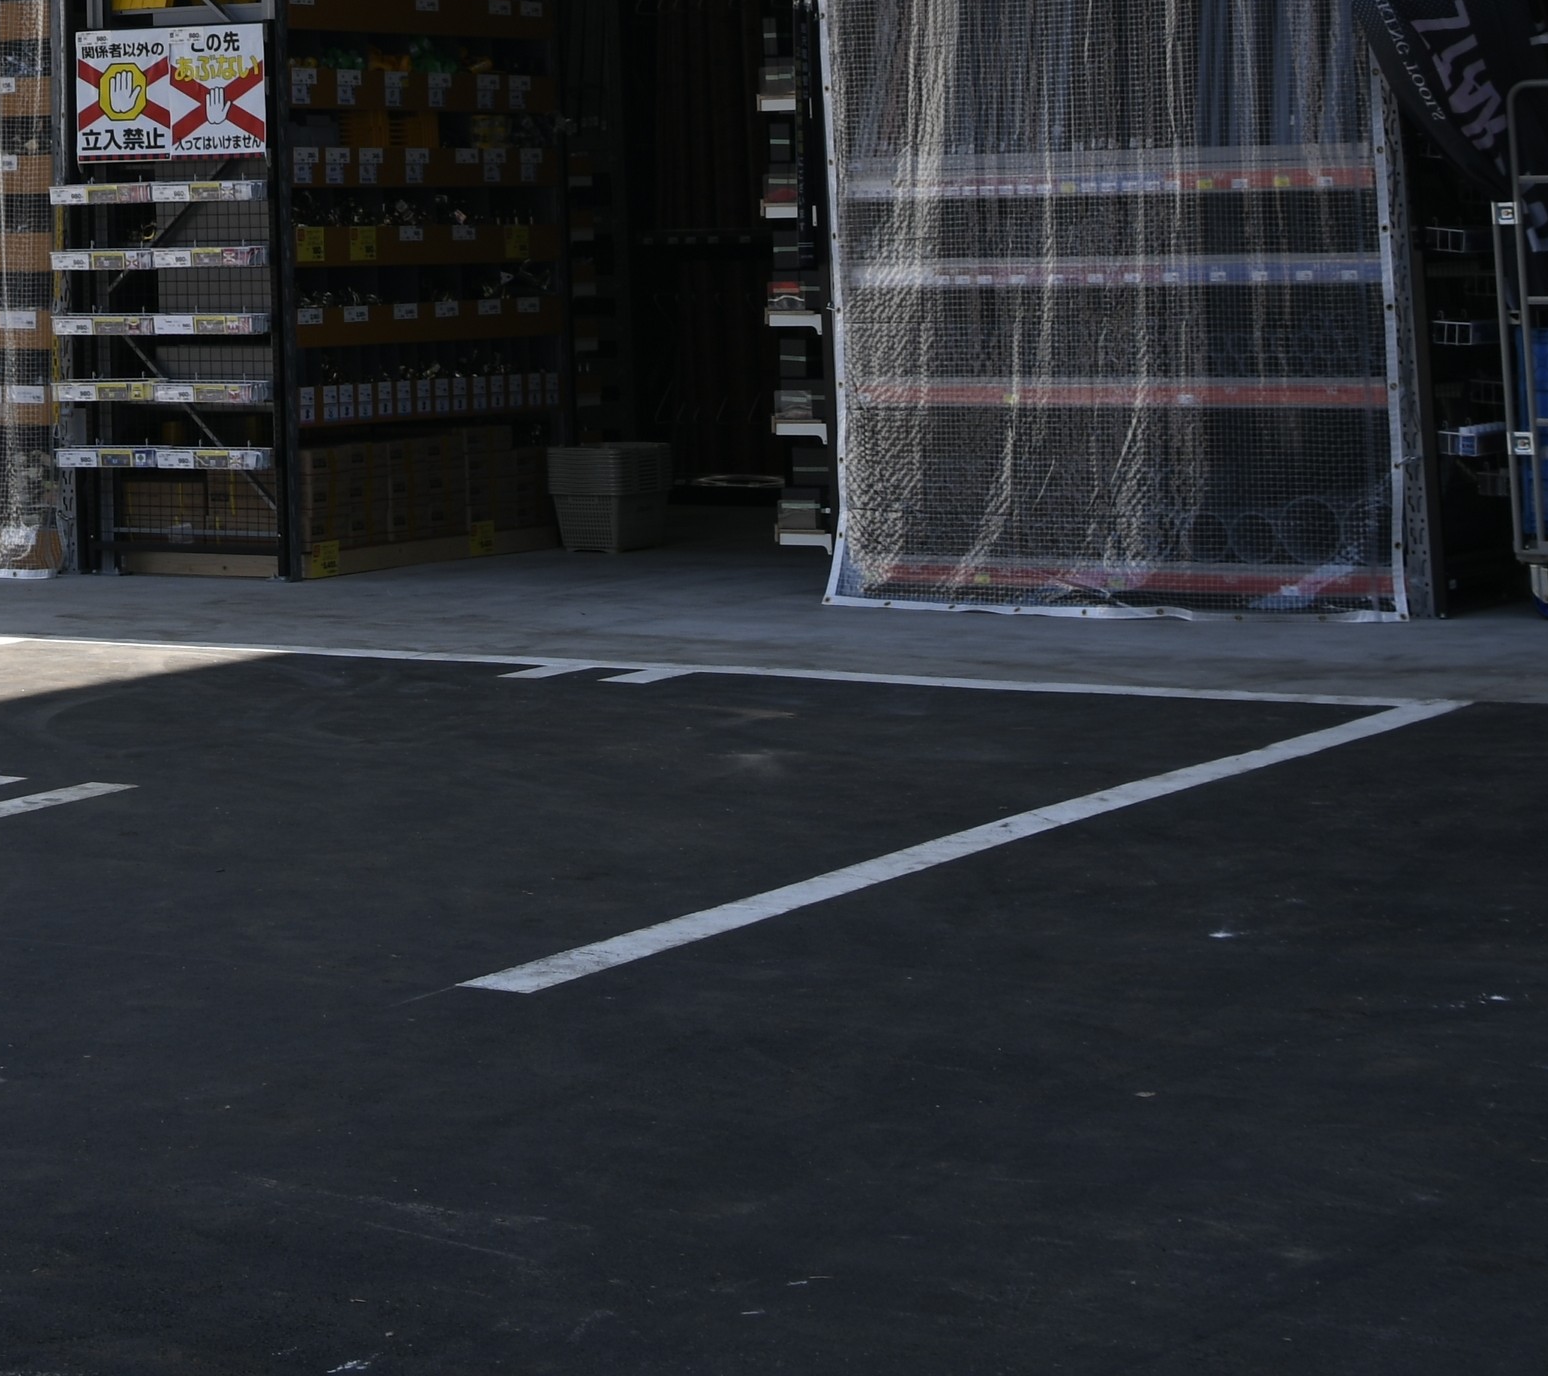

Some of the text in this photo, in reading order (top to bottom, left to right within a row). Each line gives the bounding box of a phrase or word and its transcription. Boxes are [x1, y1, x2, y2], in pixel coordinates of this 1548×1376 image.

[81, 42, 164, 59] 関係者以外の
[174, 54, 259, 82] あぶない
[82, 127, 165, 151] 立入禁止
[175, 135, 262, 152] 入ってはいけません
